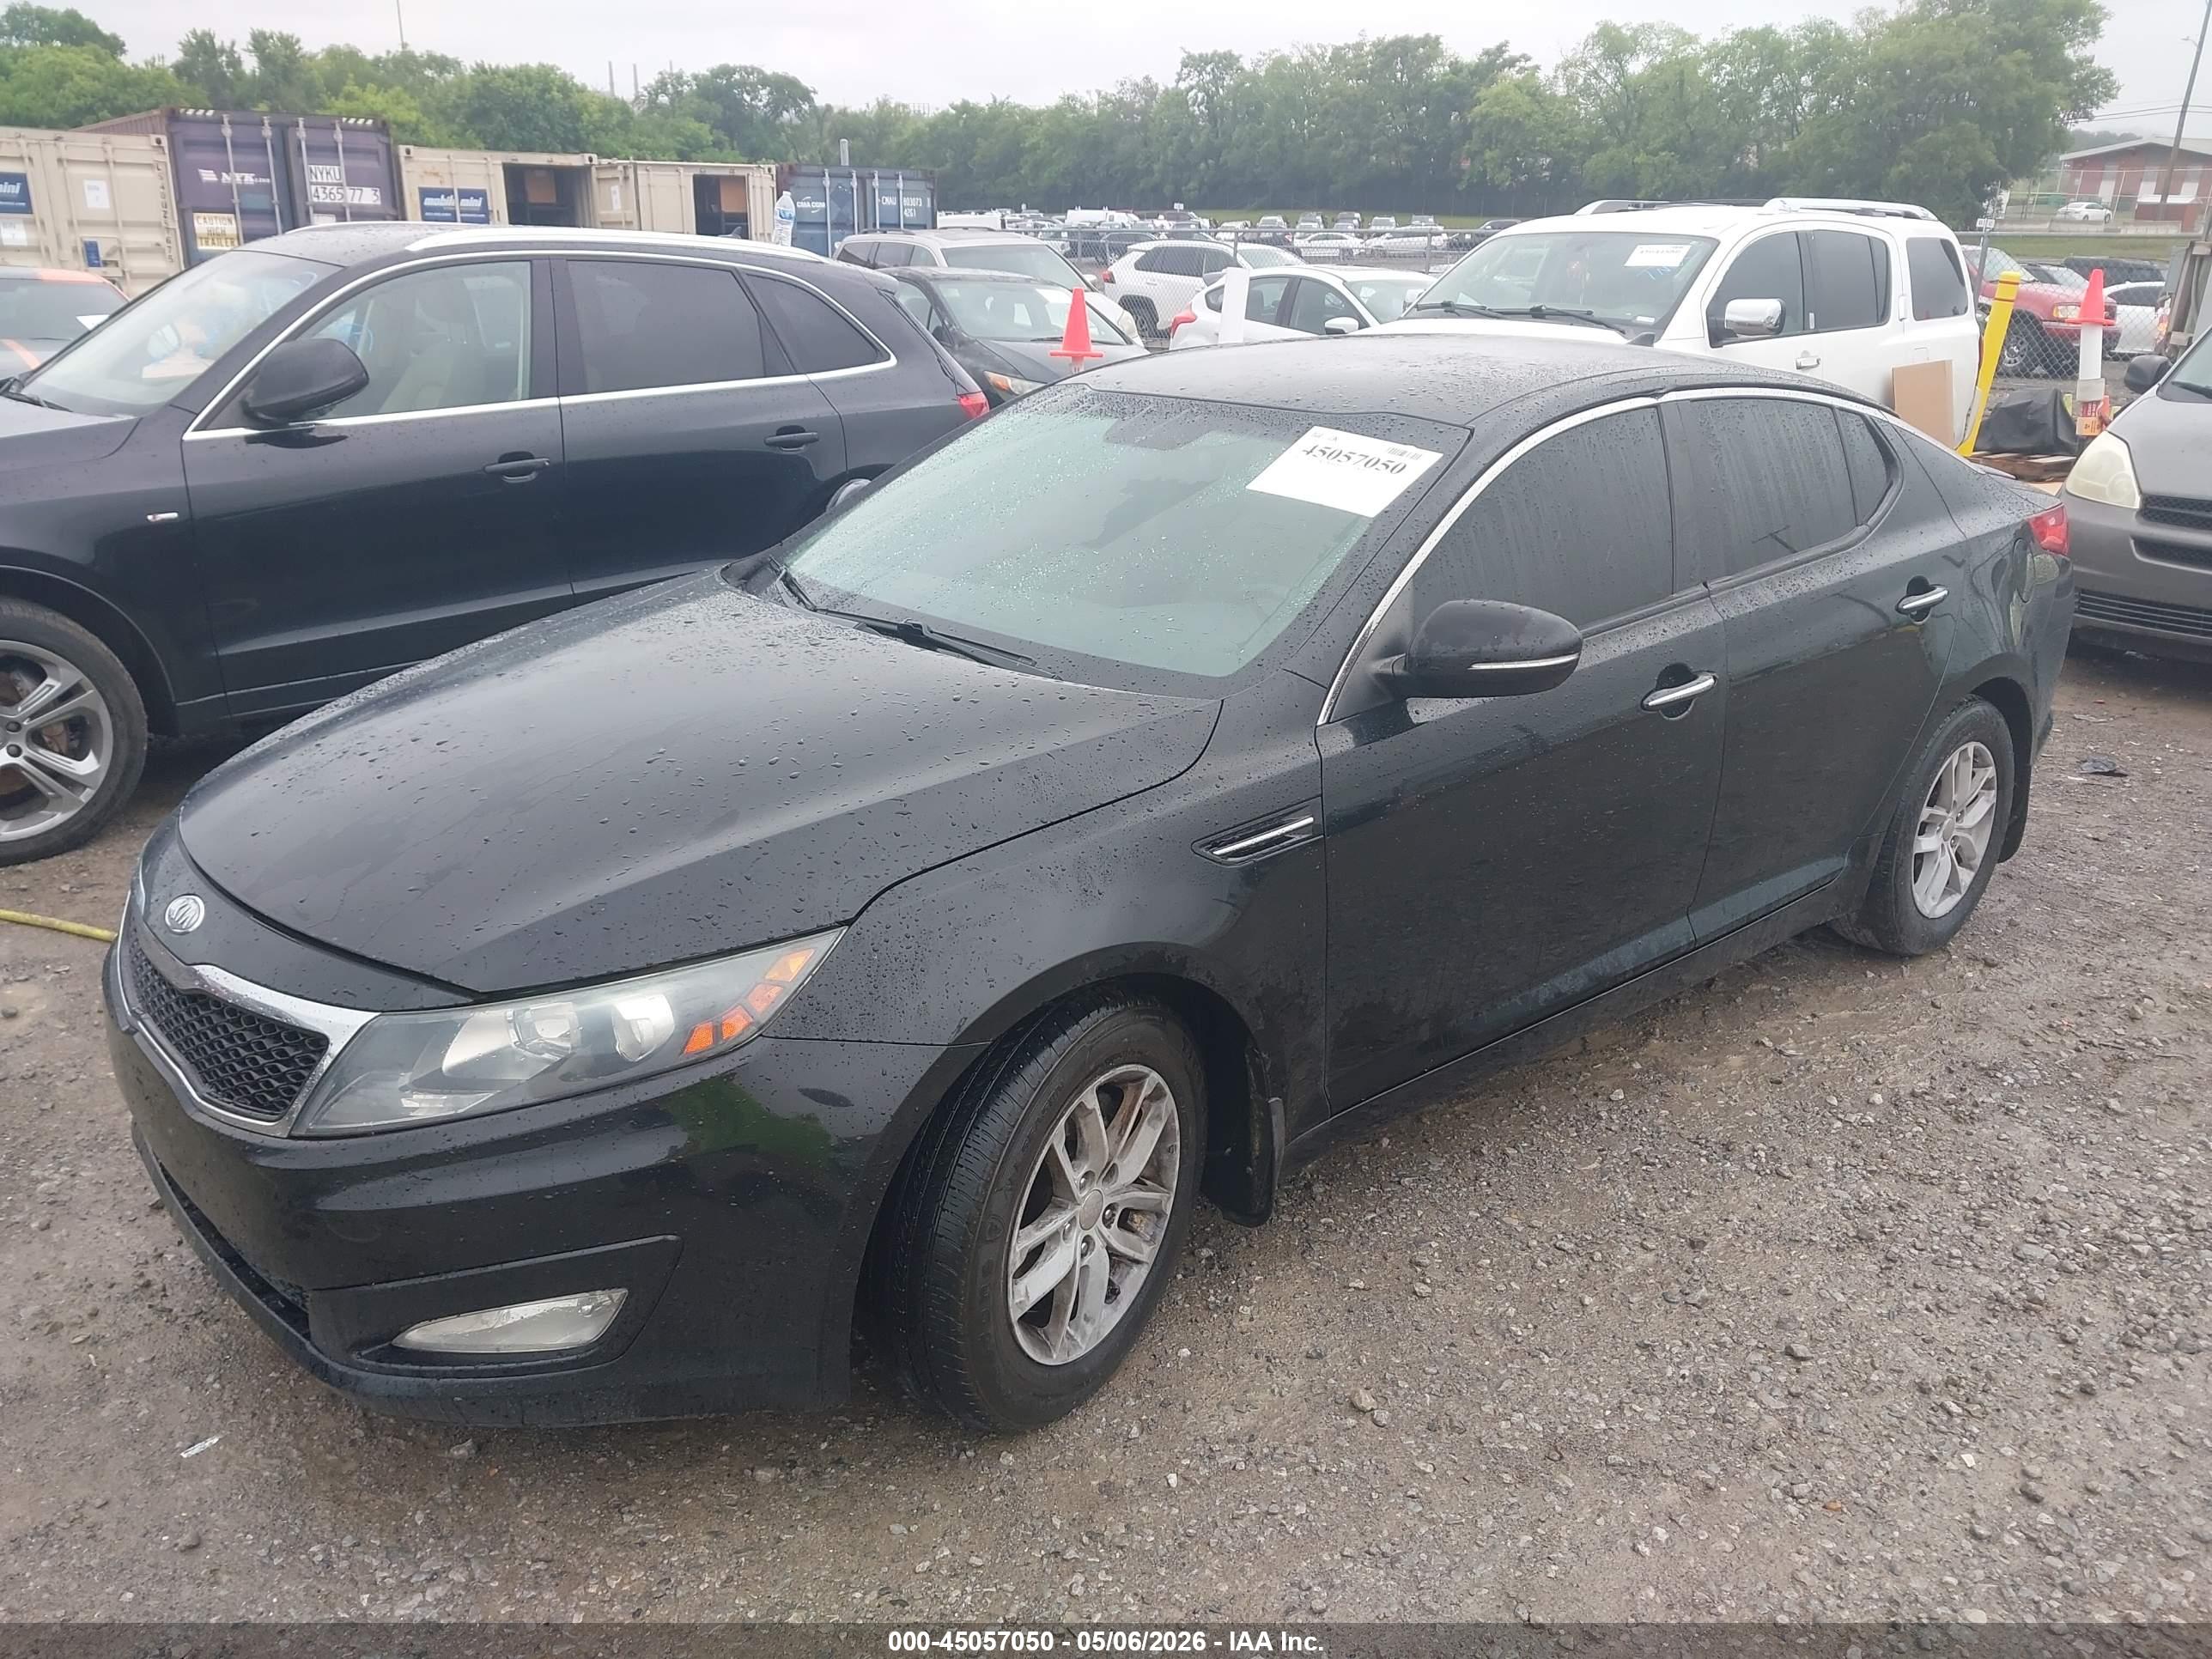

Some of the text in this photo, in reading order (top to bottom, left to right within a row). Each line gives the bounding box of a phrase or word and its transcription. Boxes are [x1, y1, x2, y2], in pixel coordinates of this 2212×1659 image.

[309, 165, 342, 181] NYKU
[196, 216, 233, 226] CAUTION
[1302, 444, 1407, 475] 45057050
